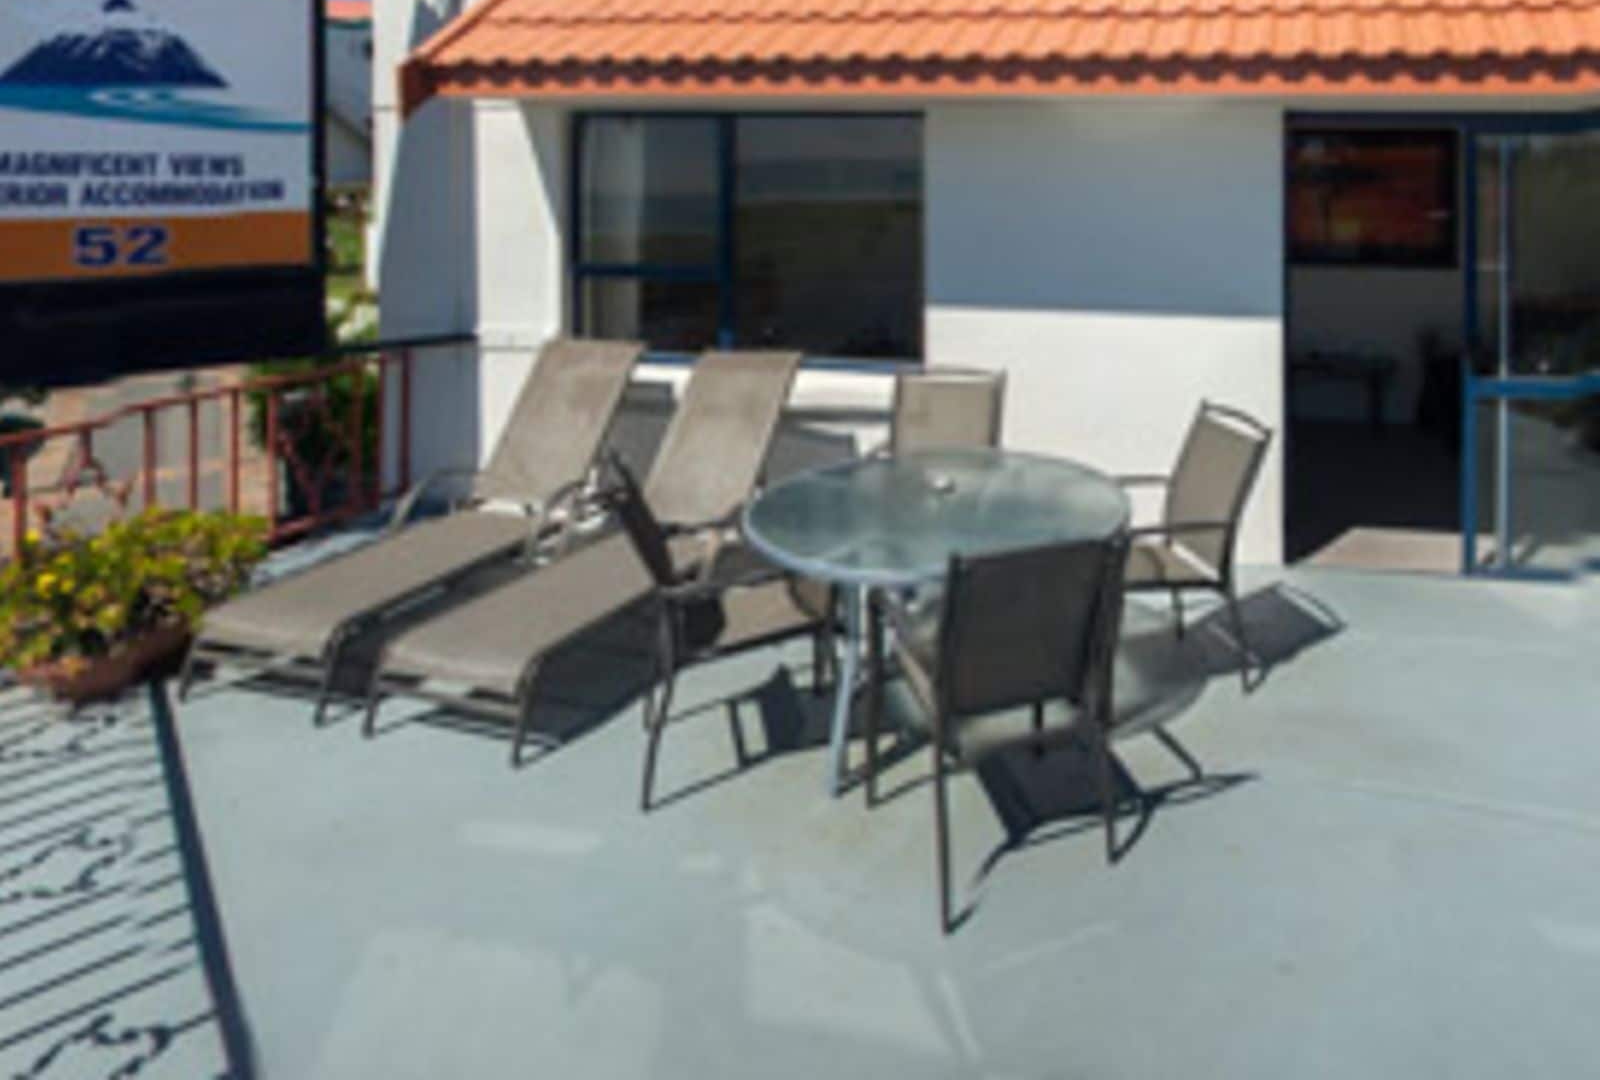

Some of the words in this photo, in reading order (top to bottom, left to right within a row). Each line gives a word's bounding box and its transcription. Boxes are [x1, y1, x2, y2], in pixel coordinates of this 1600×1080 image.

[168, 152, 244, 177] VIEWS
[79, 179, 285, 206] ACCOMMODATION
[76, 225, 168, 266] 52
